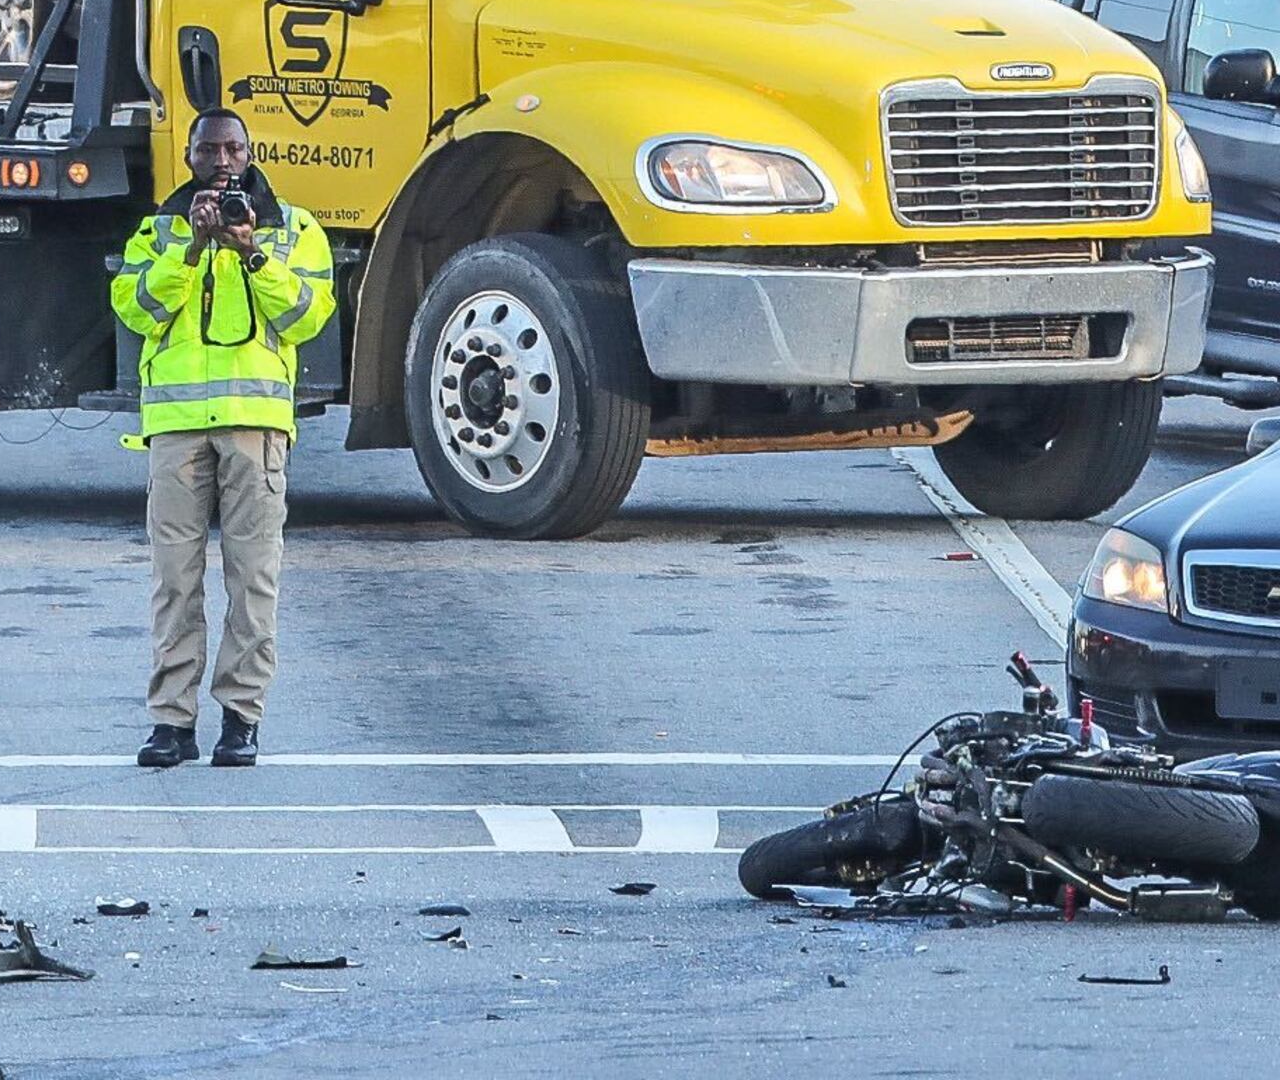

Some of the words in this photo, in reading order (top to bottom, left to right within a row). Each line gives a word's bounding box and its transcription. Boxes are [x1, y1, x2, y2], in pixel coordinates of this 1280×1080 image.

[249, 78, 286, 93] SOUTH
[288, 80, 325, 95] METRO
[327, 81, 372, 97] TOWING
[254, 104, 284, 115] ATLANTA
[330, 107, 365, 119] GEORGIA
